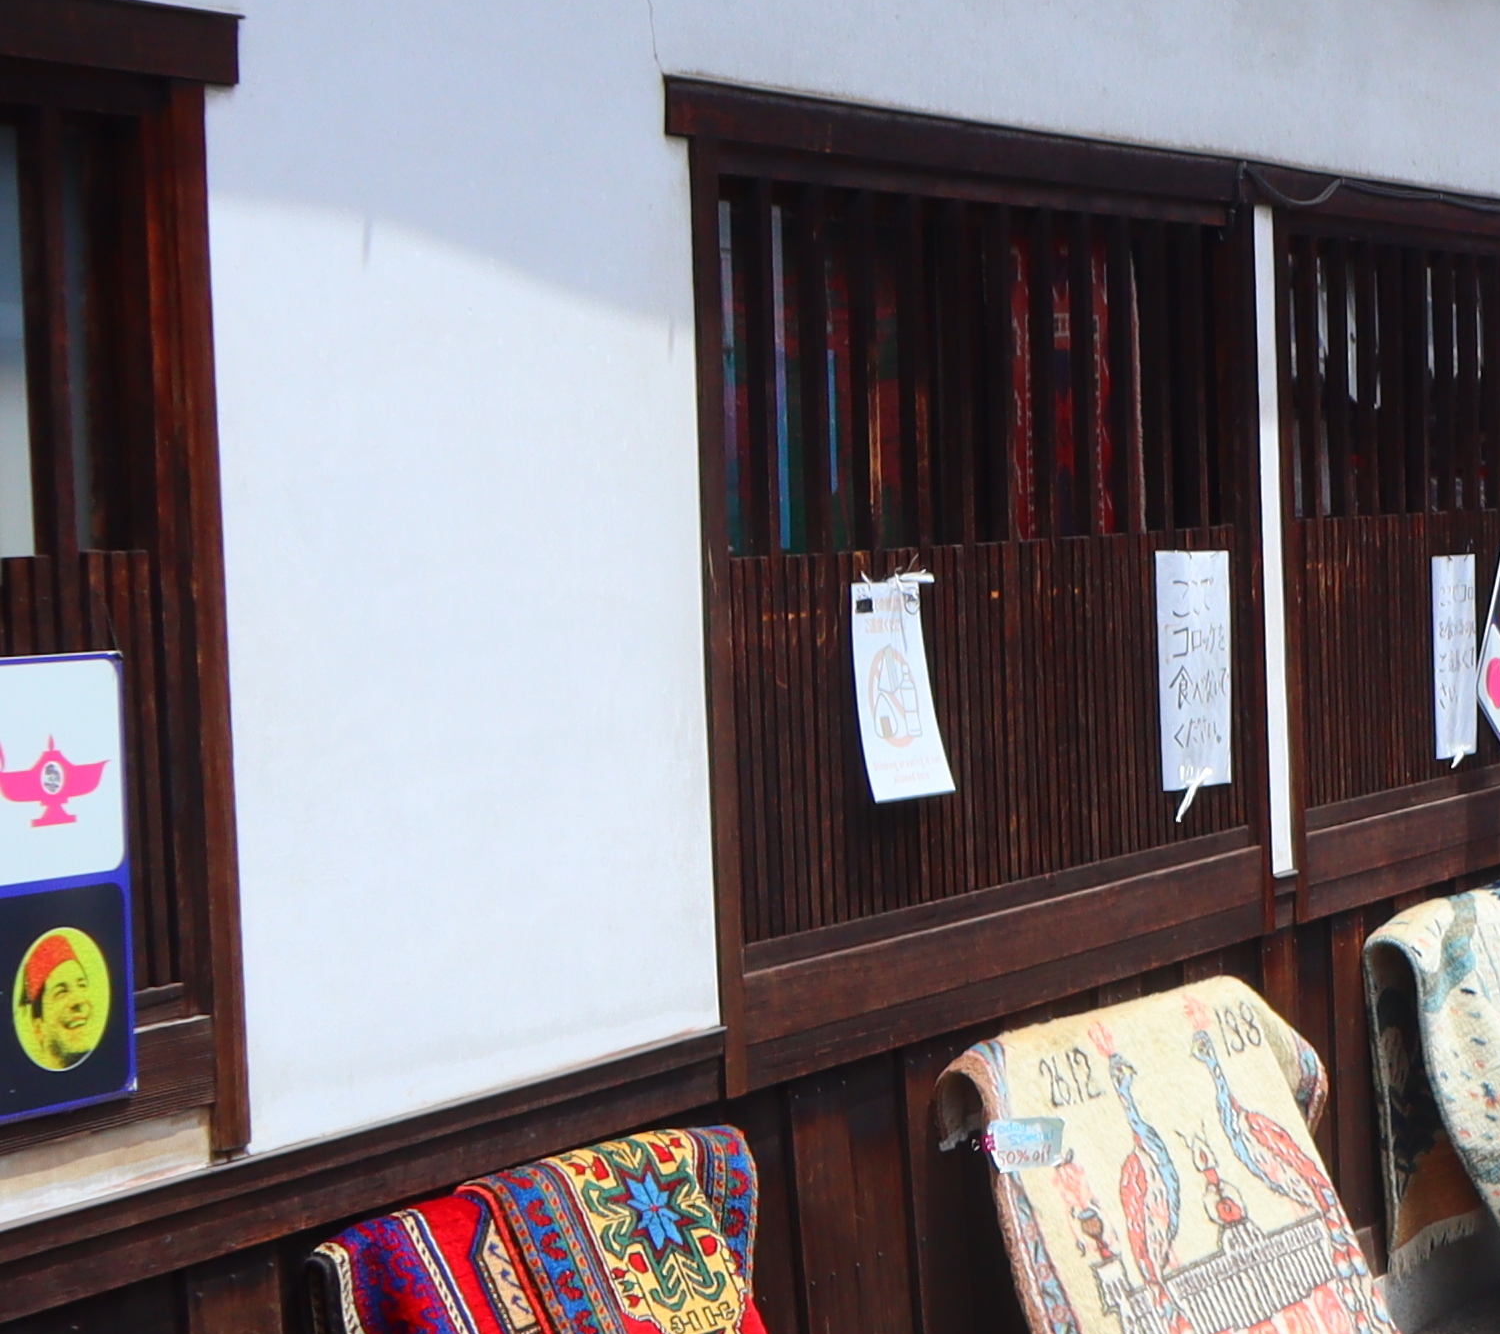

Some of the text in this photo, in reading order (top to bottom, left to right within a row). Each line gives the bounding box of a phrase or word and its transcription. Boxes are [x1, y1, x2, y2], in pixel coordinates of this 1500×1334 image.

[1172, 623, 1226, 659] コロッケを
[1169, 665, 1229, 710] 食べないで
[997, 1144, 1052, 1167] 50% off
